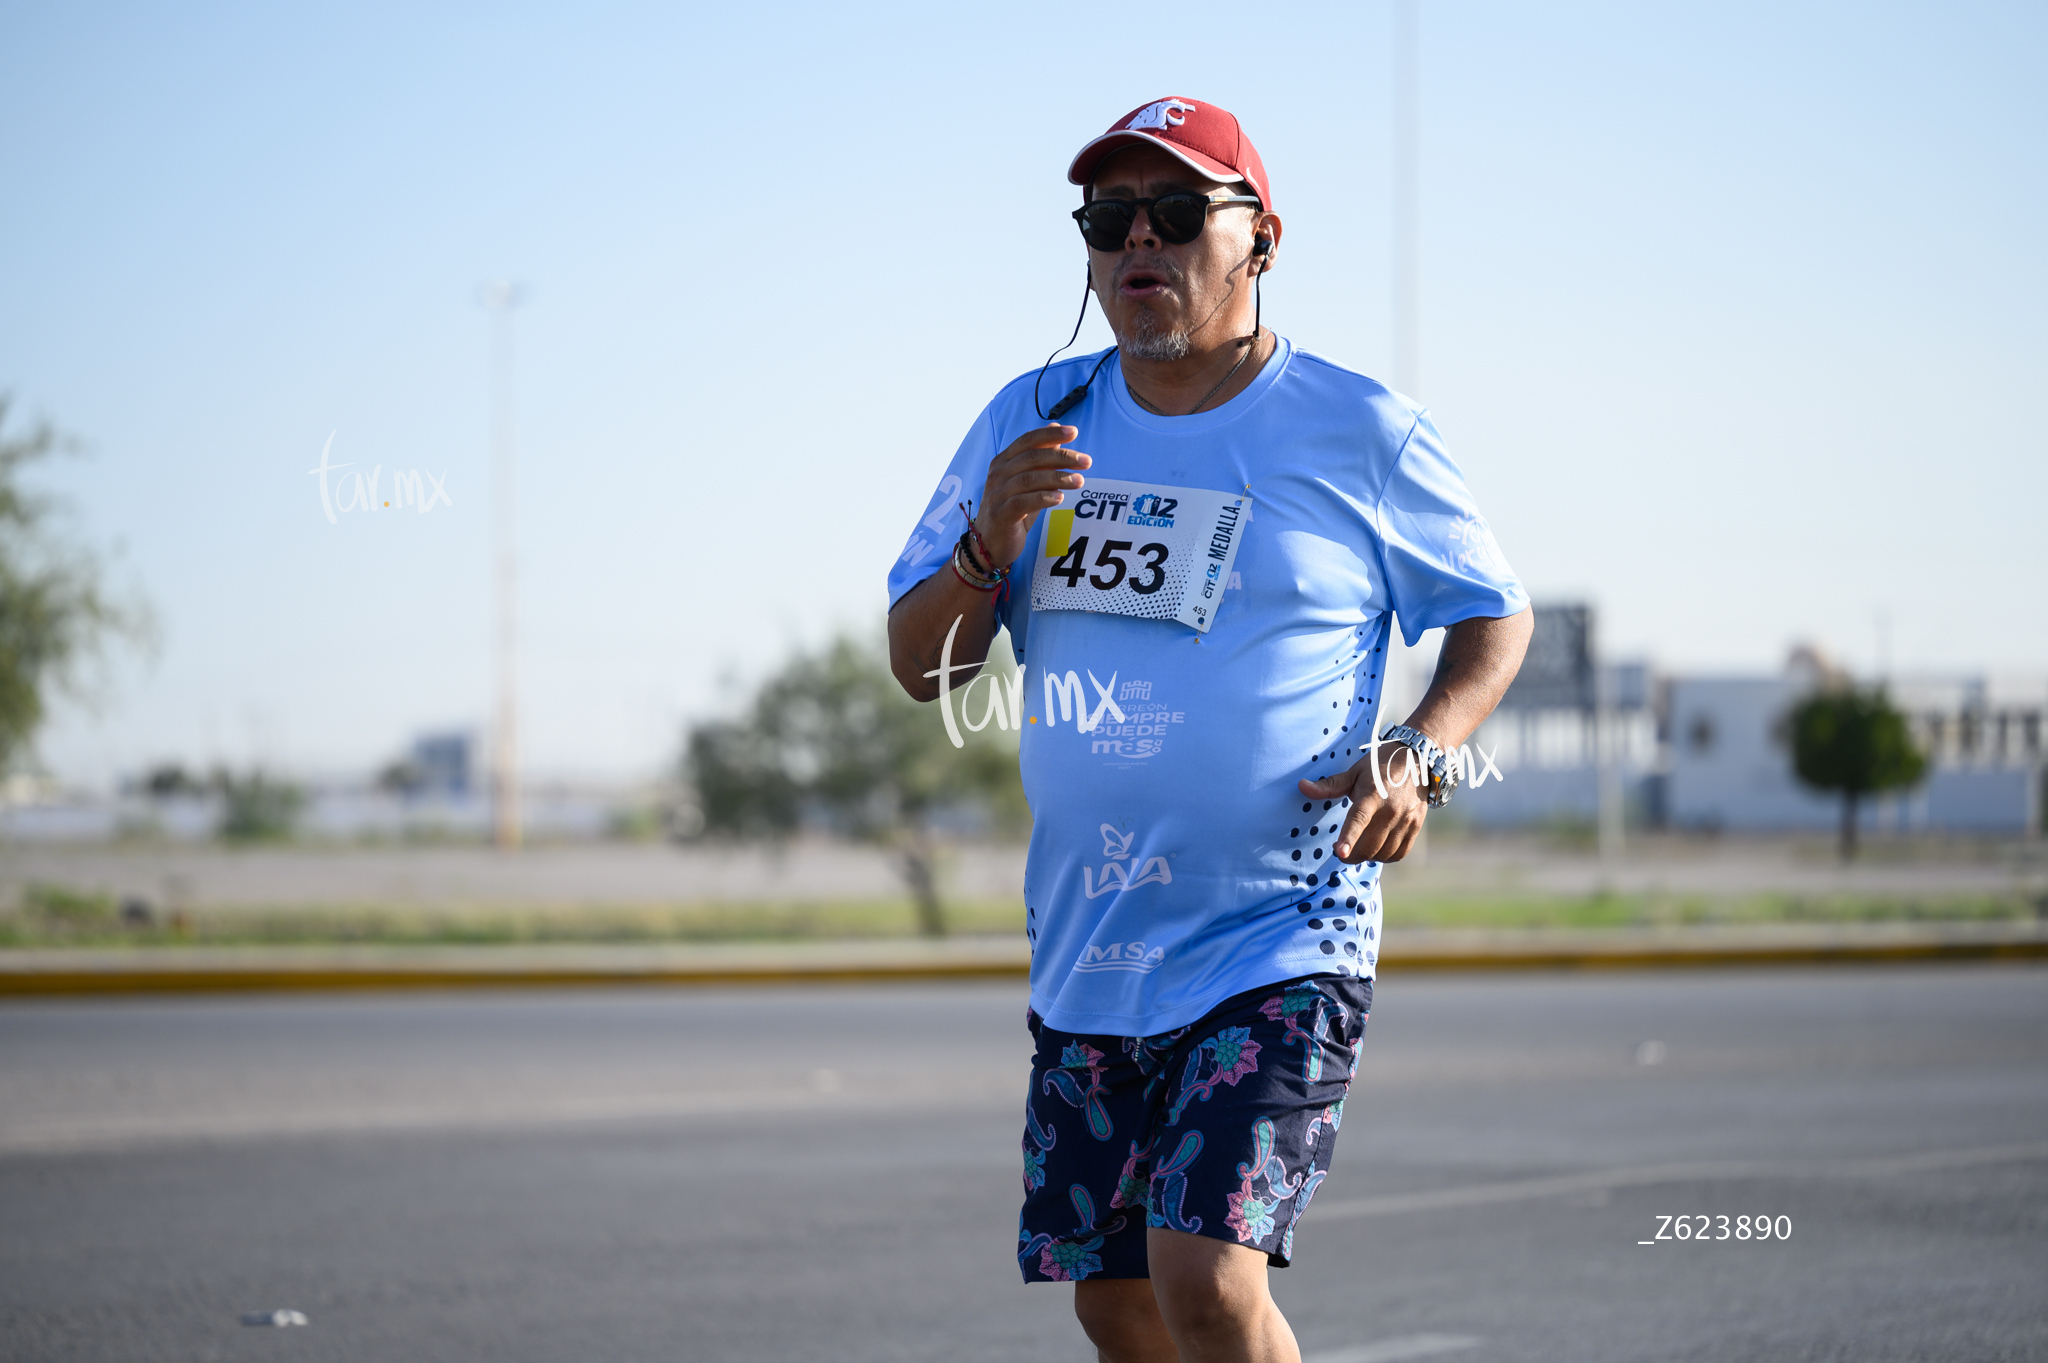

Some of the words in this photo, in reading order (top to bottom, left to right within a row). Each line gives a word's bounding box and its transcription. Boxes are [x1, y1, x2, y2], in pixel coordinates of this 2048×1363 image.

[1081, 489, 1129, 501] Carrera
[1074, 498, 1128, 522] CIT
[1127, 514, 1175, 529] EDICIÓN
[1207, 505, 1241, 562] MEDALLA
[1050, 535, 1170, 595] 453
[1204, 580, 1217, 599] CIT
[1192, 605, 1207, 617] 453
[1091, 724, 1168, 737] PUEDE
